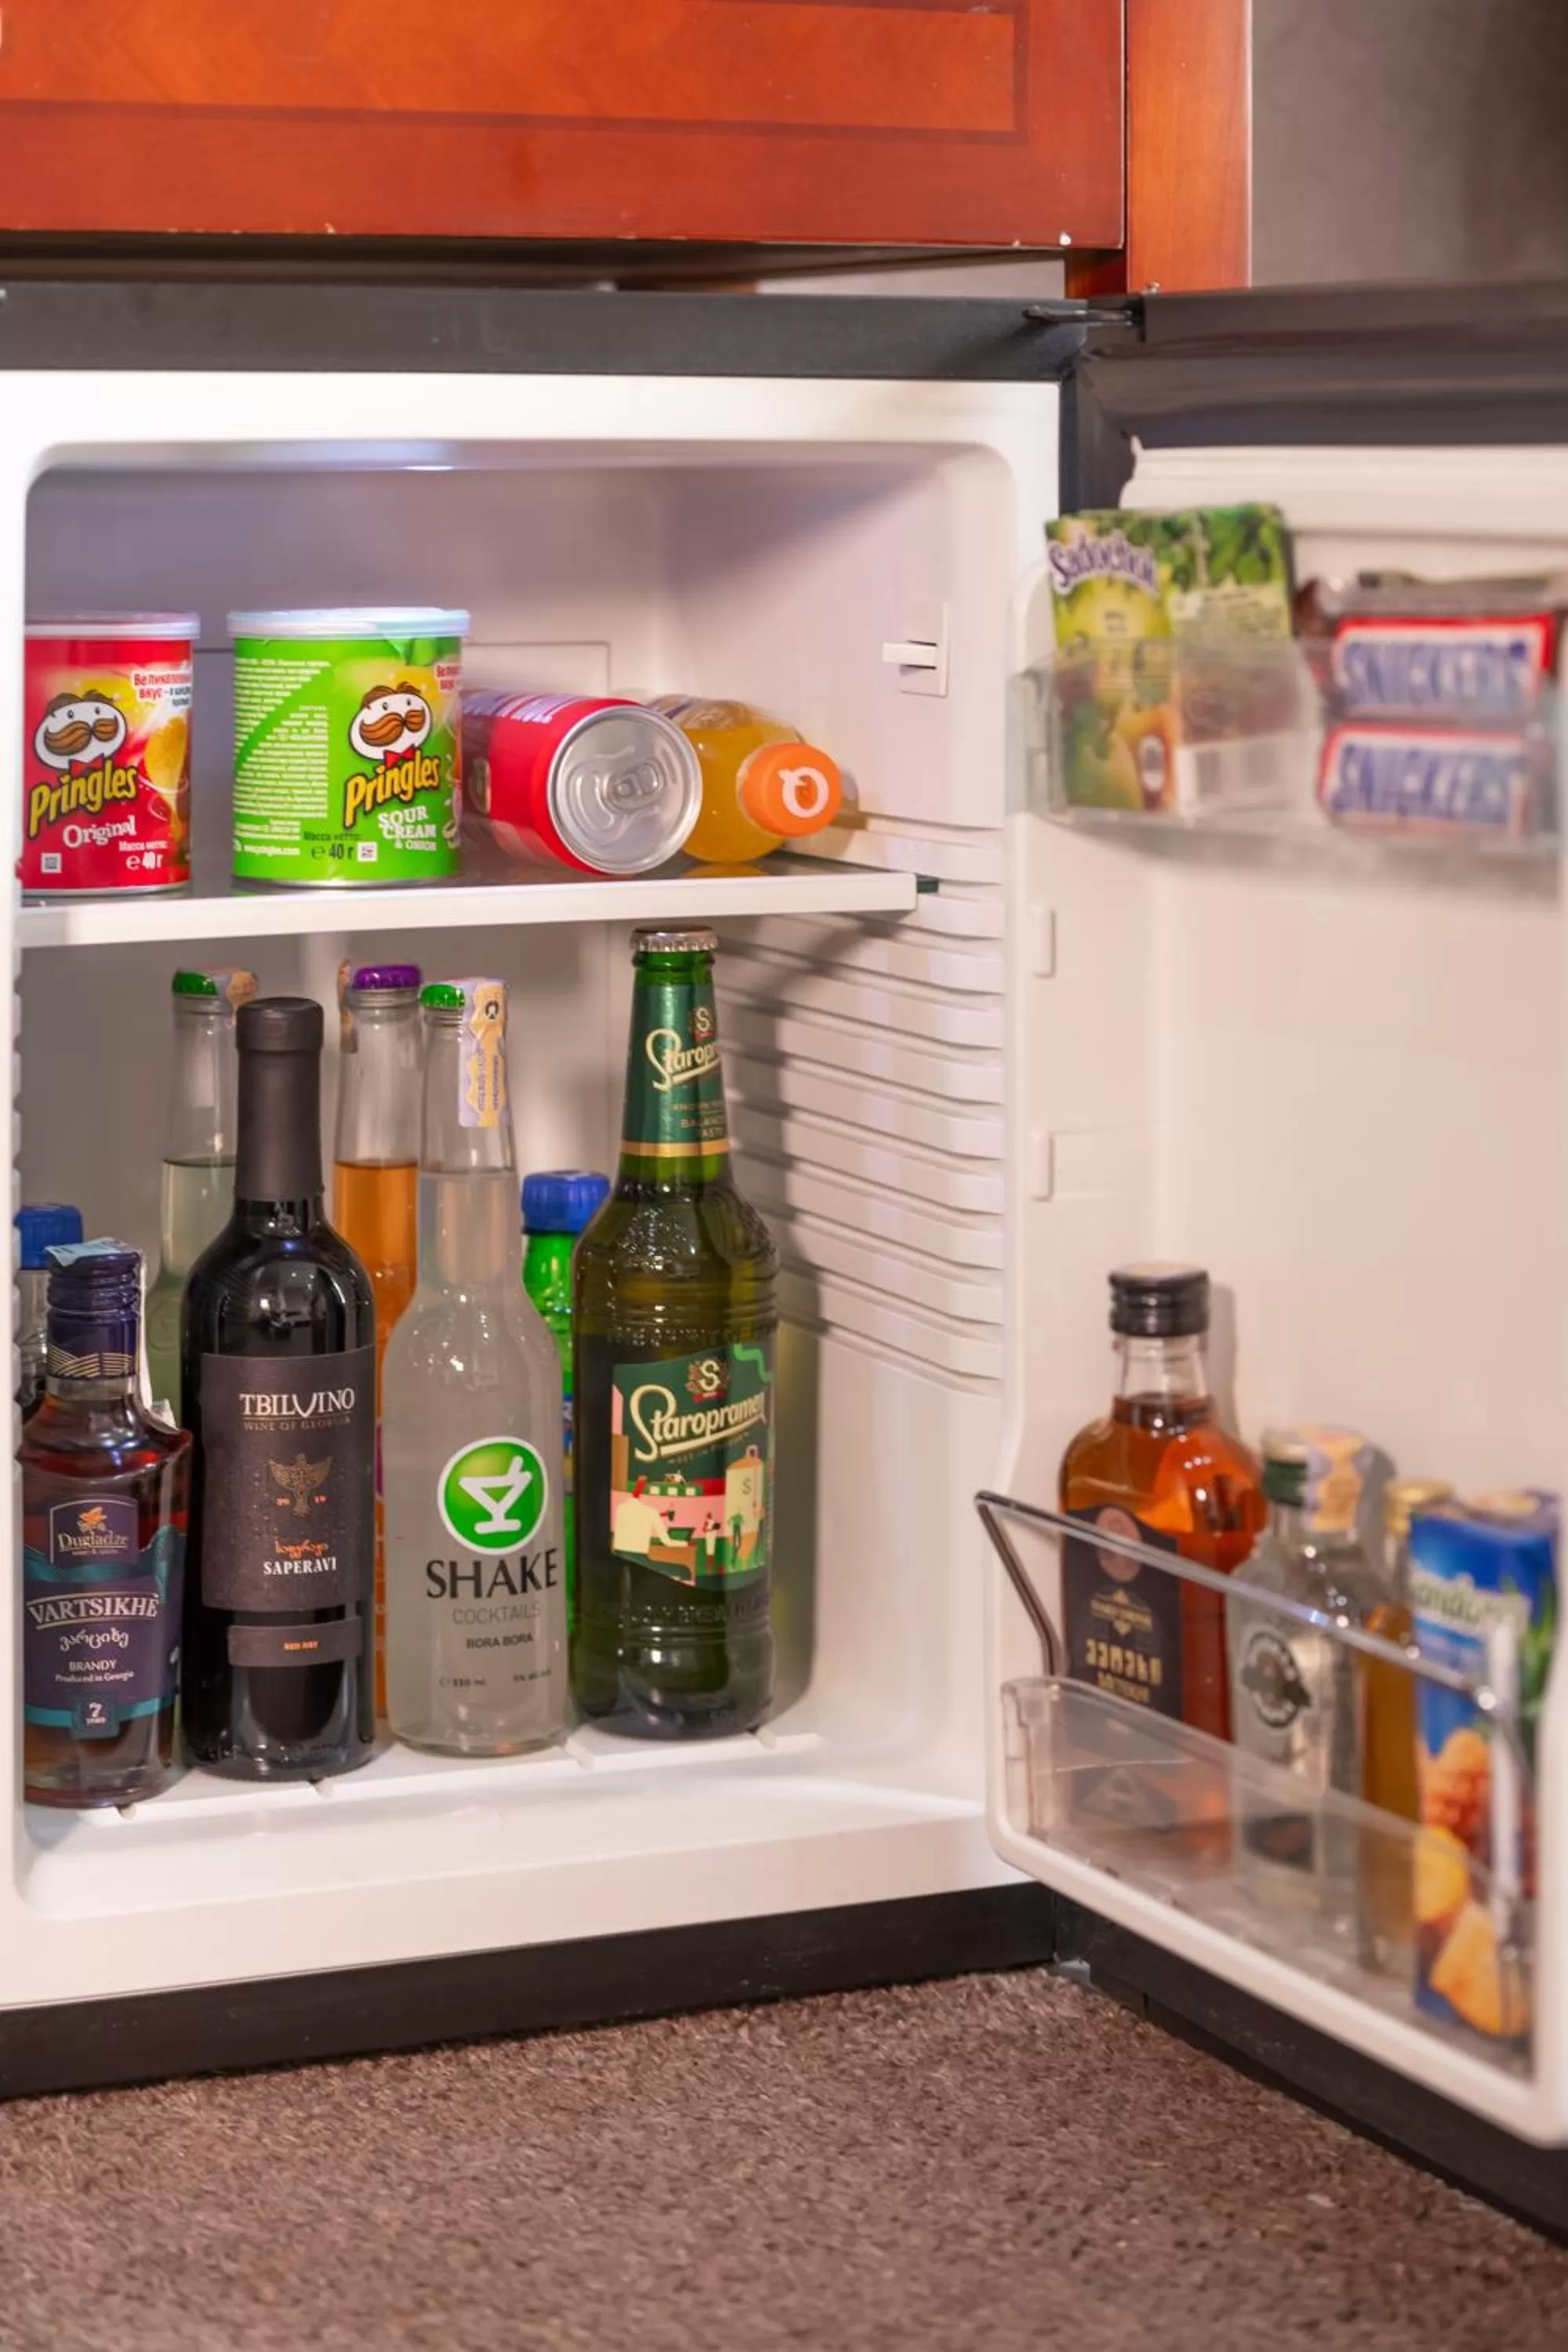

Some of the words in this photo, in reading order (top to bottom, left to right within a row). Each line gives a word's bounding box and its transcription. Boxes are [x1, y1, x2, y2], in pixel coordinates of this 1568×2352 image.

[28, 757, 139, 838] Pringles
[343, 749, 440, 829] Pringles
[63, 815, 137, 848] Original
[377, 805, 429, 829] SOUR
[383, 824, 437, 840] CREAM
[699, 1359, 720, 1391] S
[238, 1387, 355, 1417] TBILVINO
[630, 1384, 766, 1462] Staropramen
[263, 1556, 337, 1575] SAPERAVI
[426, 1547, 558, 1599] SHAKE
[452, 1602, 541, 1625] COCKTAILS
[68, 1659, 117, 1671] BRANDY
[88, 1702, 103, 1718] 7
